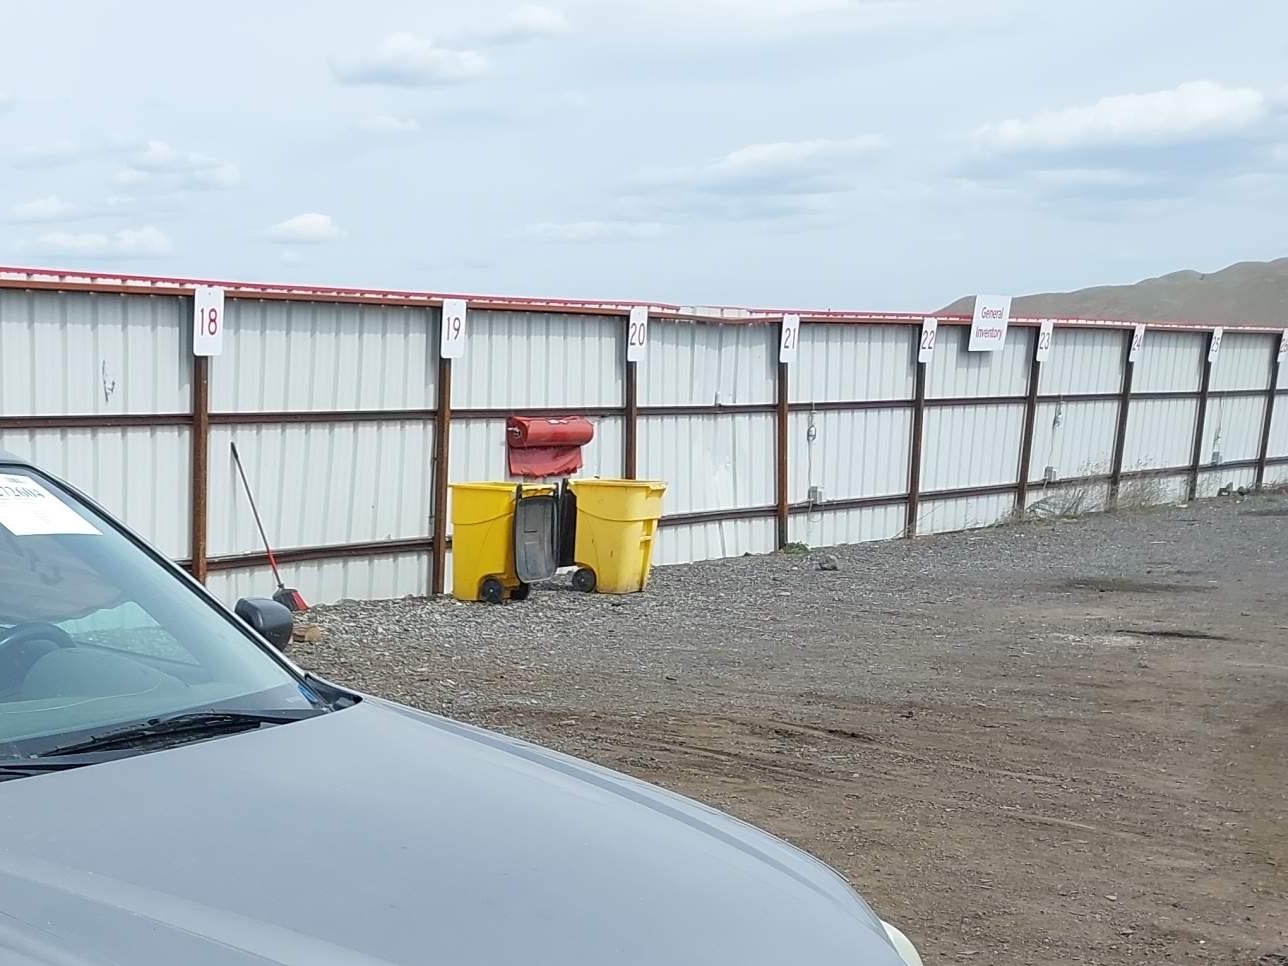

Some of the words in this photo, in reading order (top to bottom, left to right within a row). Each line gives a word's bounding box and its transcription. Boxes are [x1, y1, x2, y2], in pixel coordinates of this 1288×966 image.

[200, 307, 218, 336] 18
[981, 306, 1005, 320] General
[446, 316, 461, 341] 19
[629, 322, 646, 346] 20
[783, 327, 797, 349] 21
[975, 327, 1003, 341] Inventory
[921, 330, 935, 350] 22
[1039, 332, 1051, 350] 23
